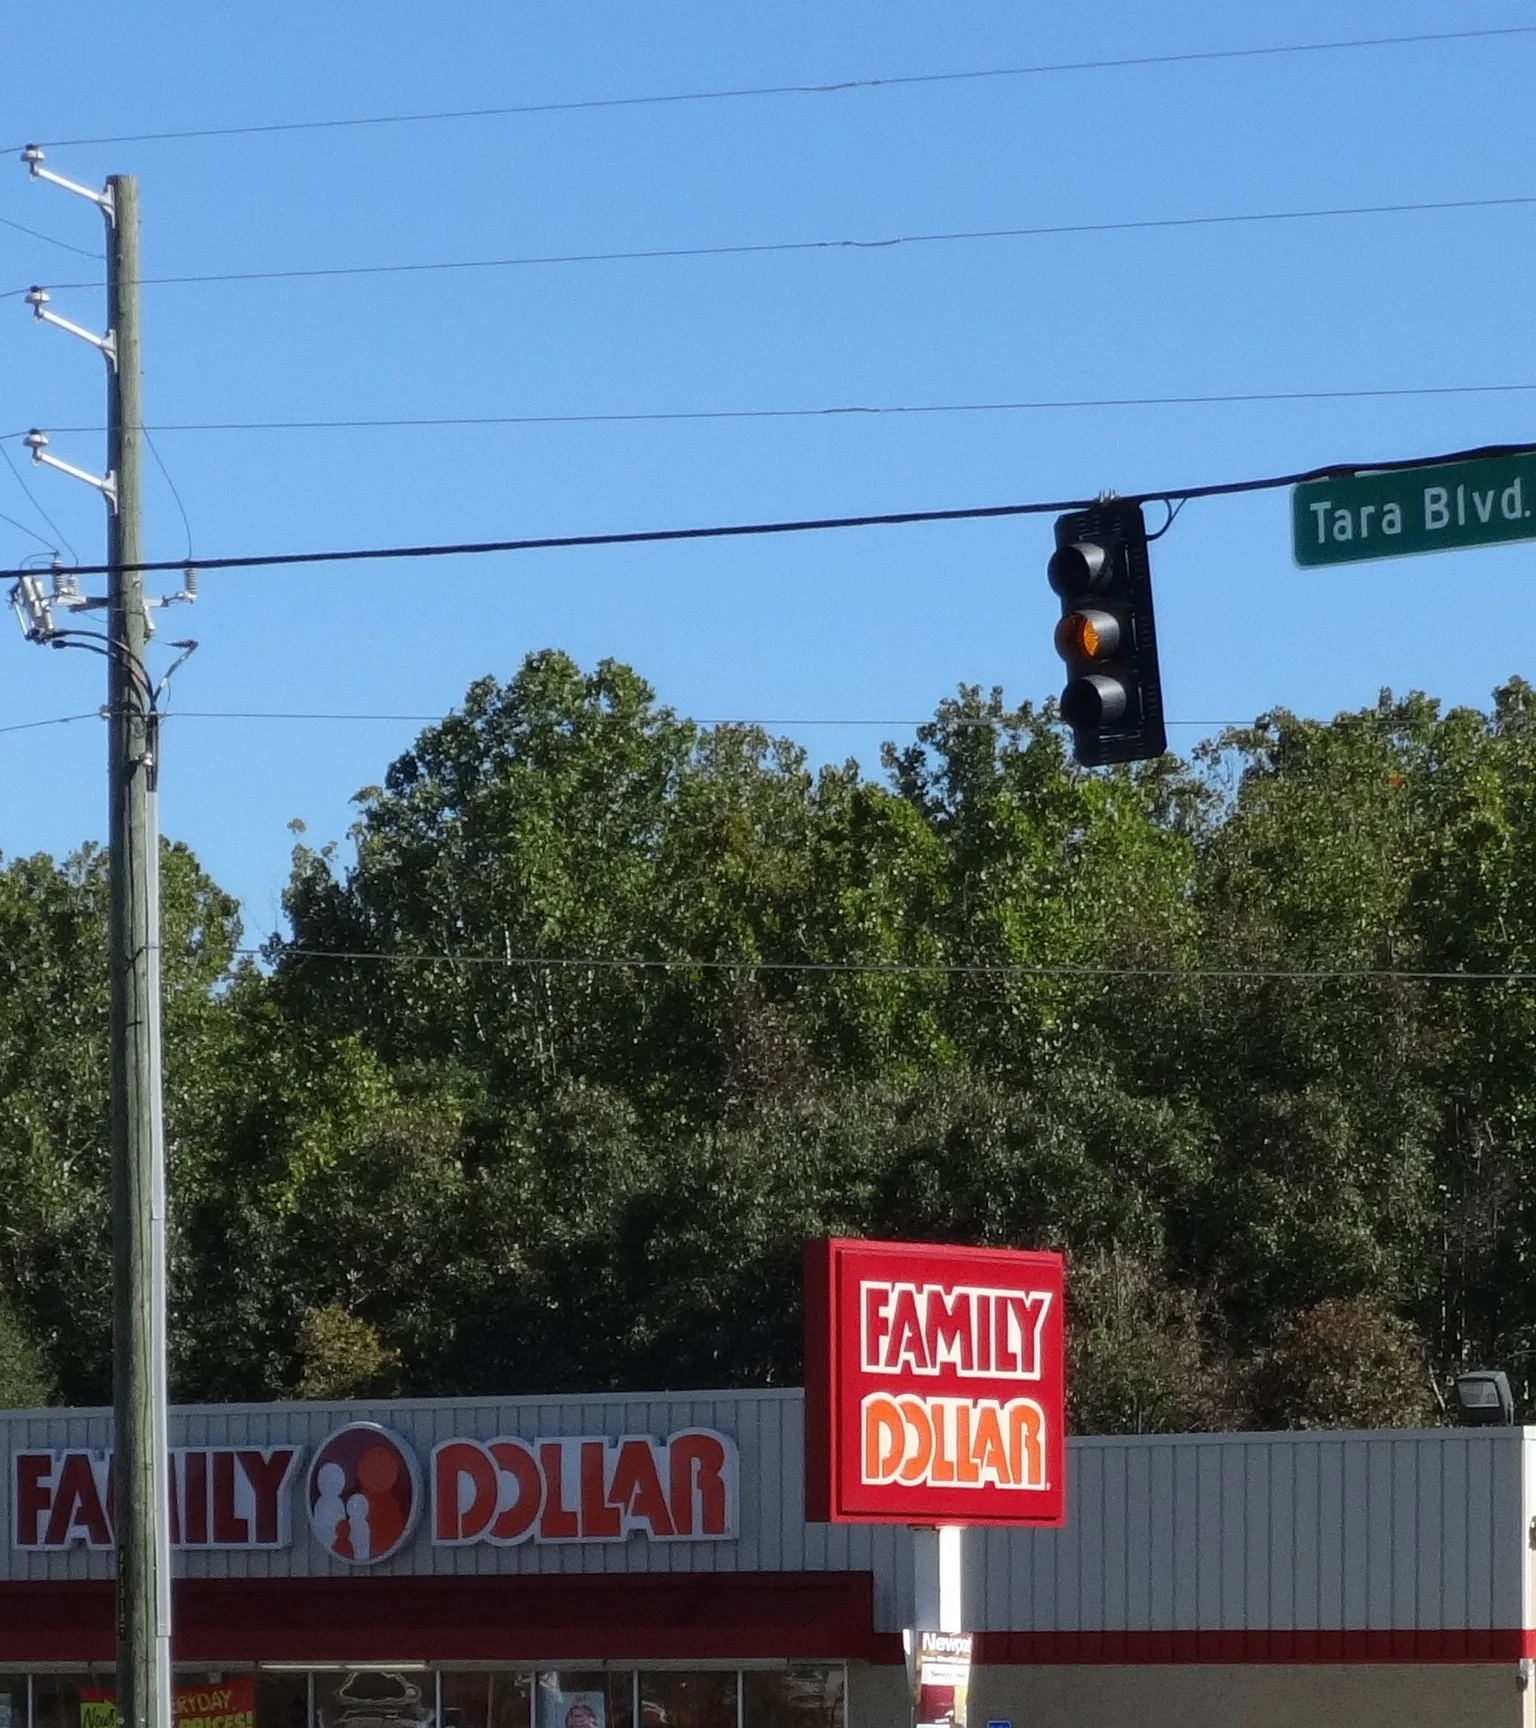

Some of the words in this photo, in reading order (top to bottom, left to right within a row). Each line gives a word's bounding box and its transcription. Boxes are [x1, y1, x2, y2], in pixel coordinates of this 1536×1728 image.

[1310, 500, 1402, 544] Tara
[1424, 476, 1532, 530] Blvd.
[863, 1284, 1050, 1377] FAMILY
[864, 1395, 1044, 1487] DOLLAR
[15, 1450, 294, 1546] FAILY
[435, 1434, 728, 1541] DOLLAR
